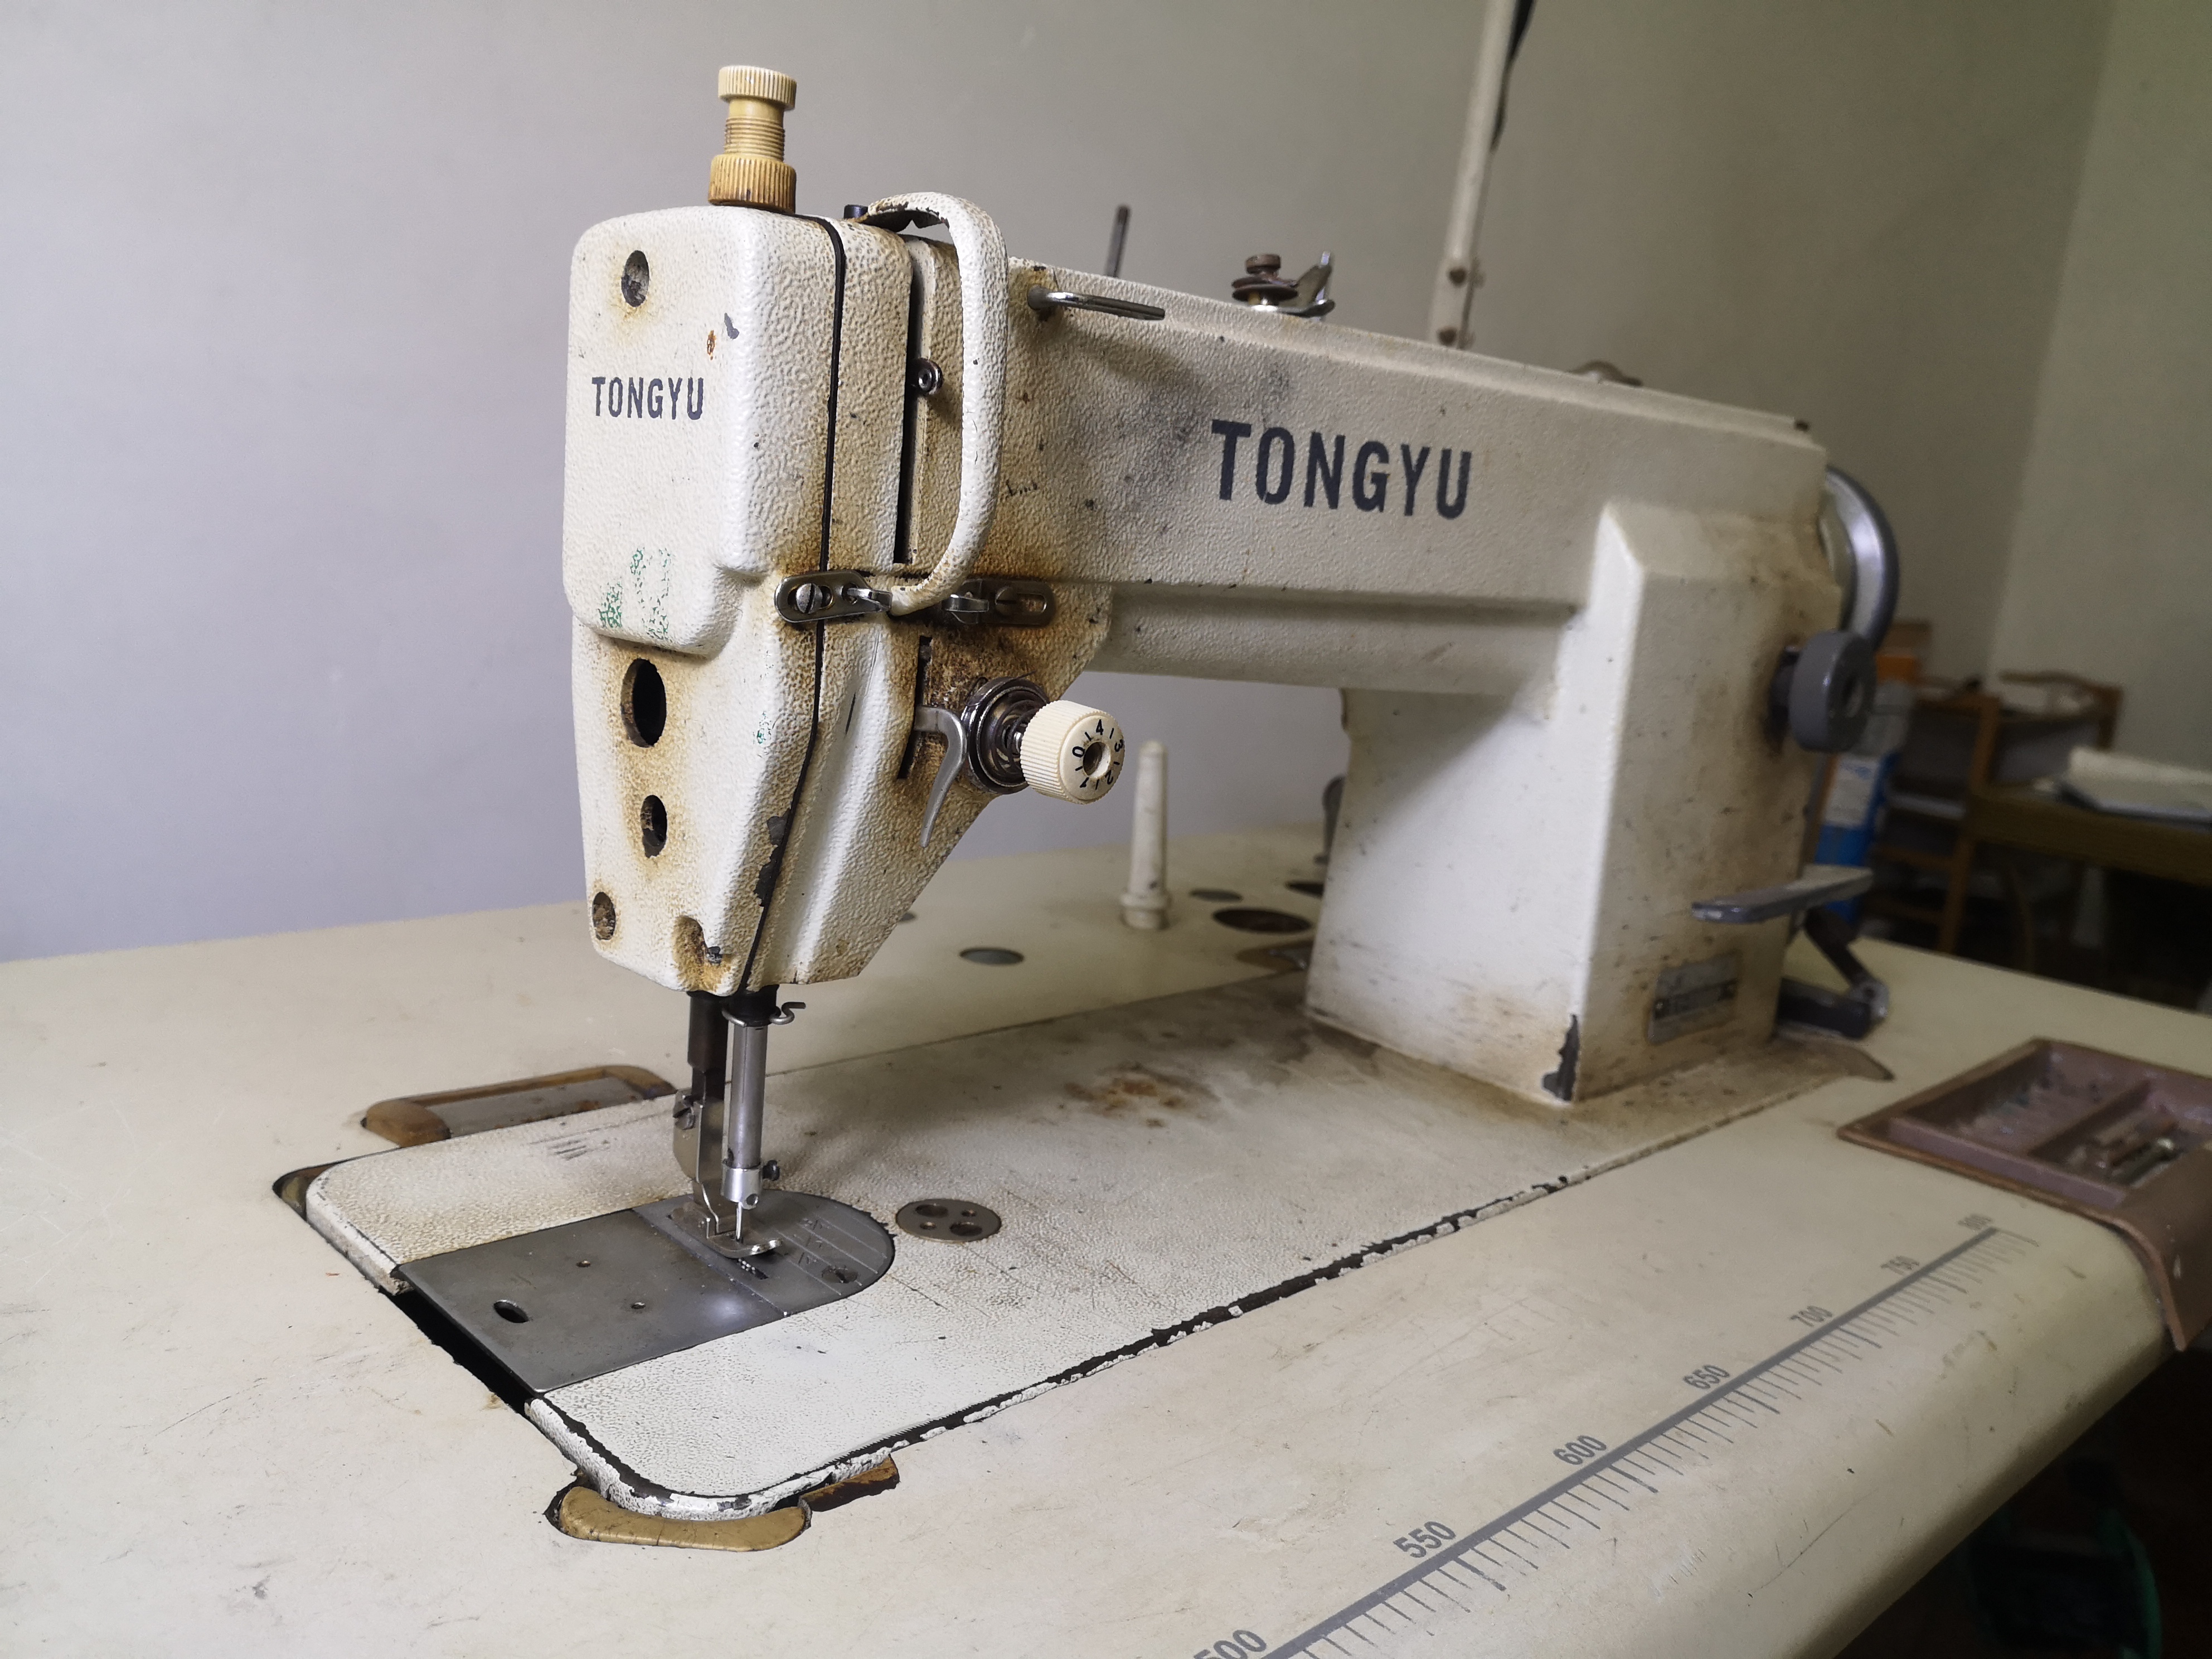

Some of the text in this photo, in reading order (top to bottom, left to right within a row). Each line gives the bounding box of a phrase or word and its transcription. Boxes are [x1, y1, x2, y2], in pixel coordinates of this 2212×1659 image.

[591, 376, 704, 420] TONGYU
[1211, 419, 1472, 520] TONGYU
[1096, 719, 1104, 735] 4
[1072, 746, 1085, 758] 0
[1114, 739, 1124, 752] 3
[1079, 777, 1089, 788] 1
[1105, 770, 1114, 784] 2
[1791, 1306, 1833, 1327] 700
[1682, 1364, 1730, 1389] 650
[1553, 1435, 1607, 1465] 600
[1393, 1521, 1456, 1558] 550
